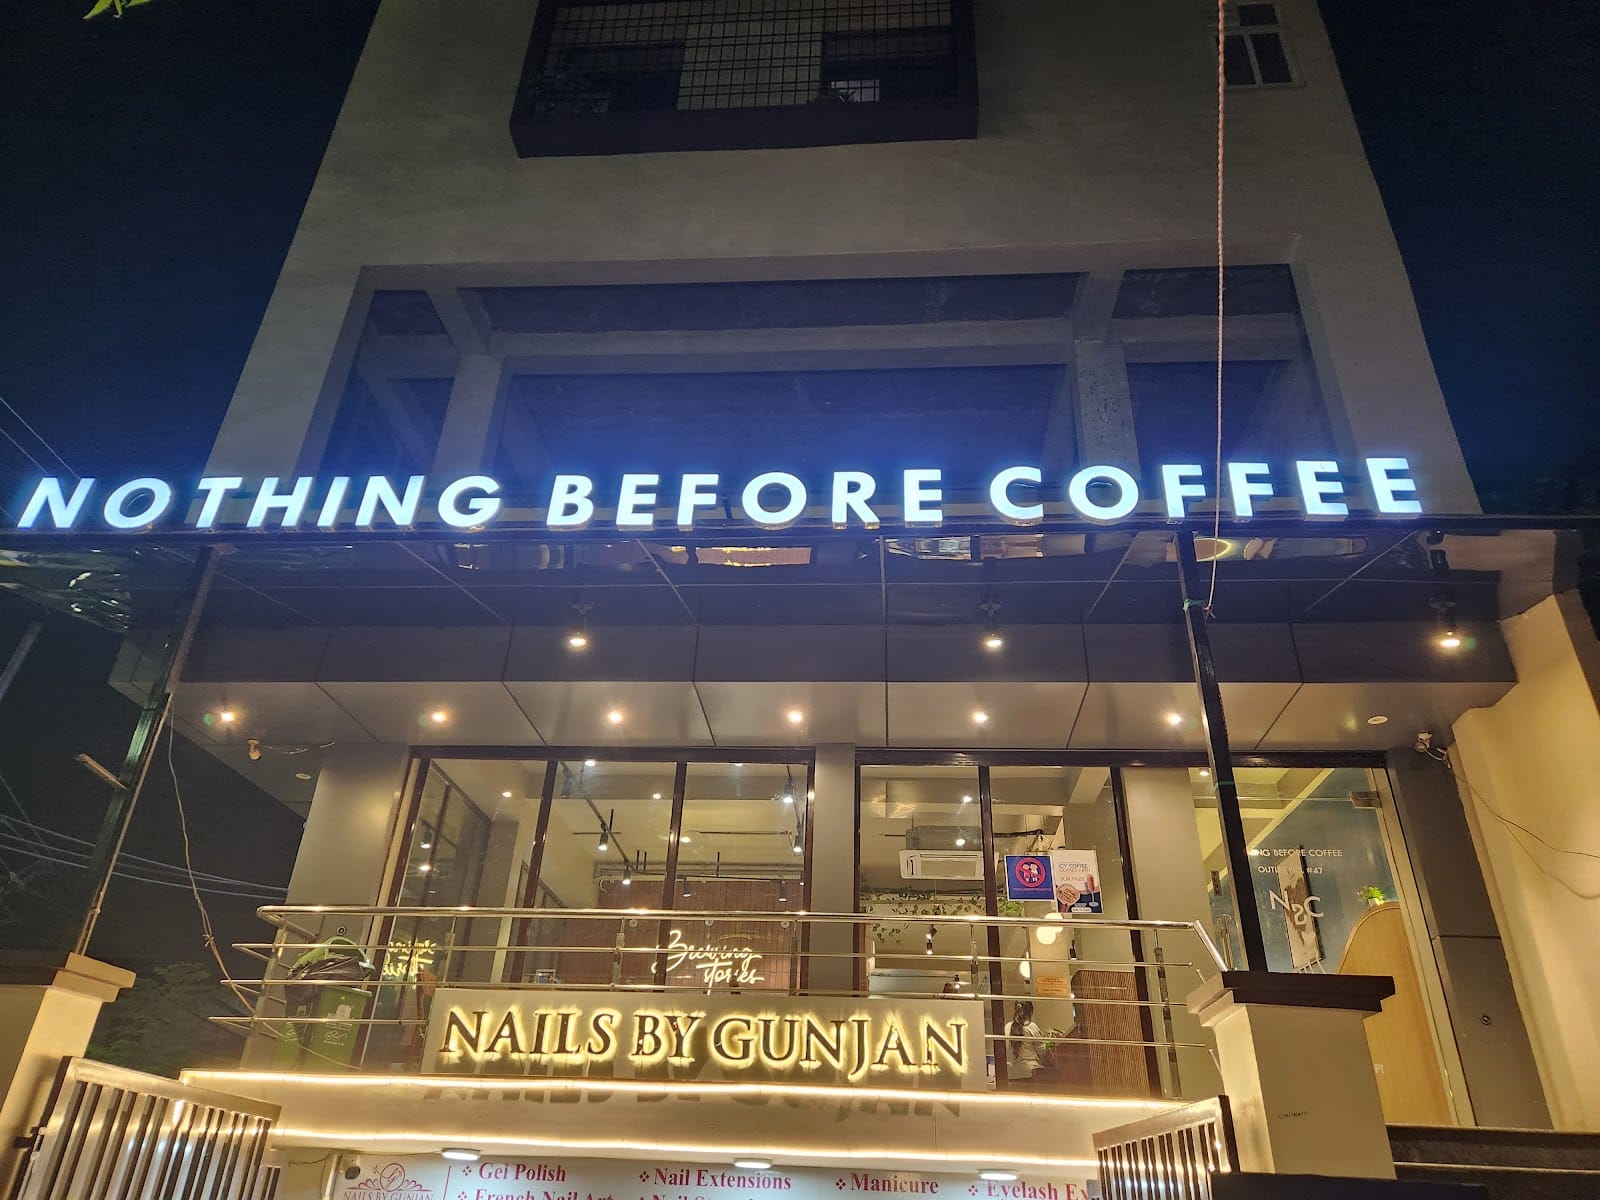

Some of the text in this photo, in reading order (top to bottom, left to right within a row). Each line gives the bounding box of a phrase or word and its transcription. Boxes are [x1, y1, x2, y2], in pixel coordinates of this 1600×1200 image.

[17, 457, 1423, 530] NOTHING BEFORE COFFEE
[1308, 849, 1343, 857] COFFEE
[1257, 866, 1287, 874] OUTL
[439, 1009, 968, 1077] NAILS BY GUNJAN
[514, 1163, 567, 1182] Polish
[654, 1167, 792, 1190] Nail Extensions
[851, 1172, 939, 1194] Manicure
[987, 1180, 1058, 1200] Eyelash
